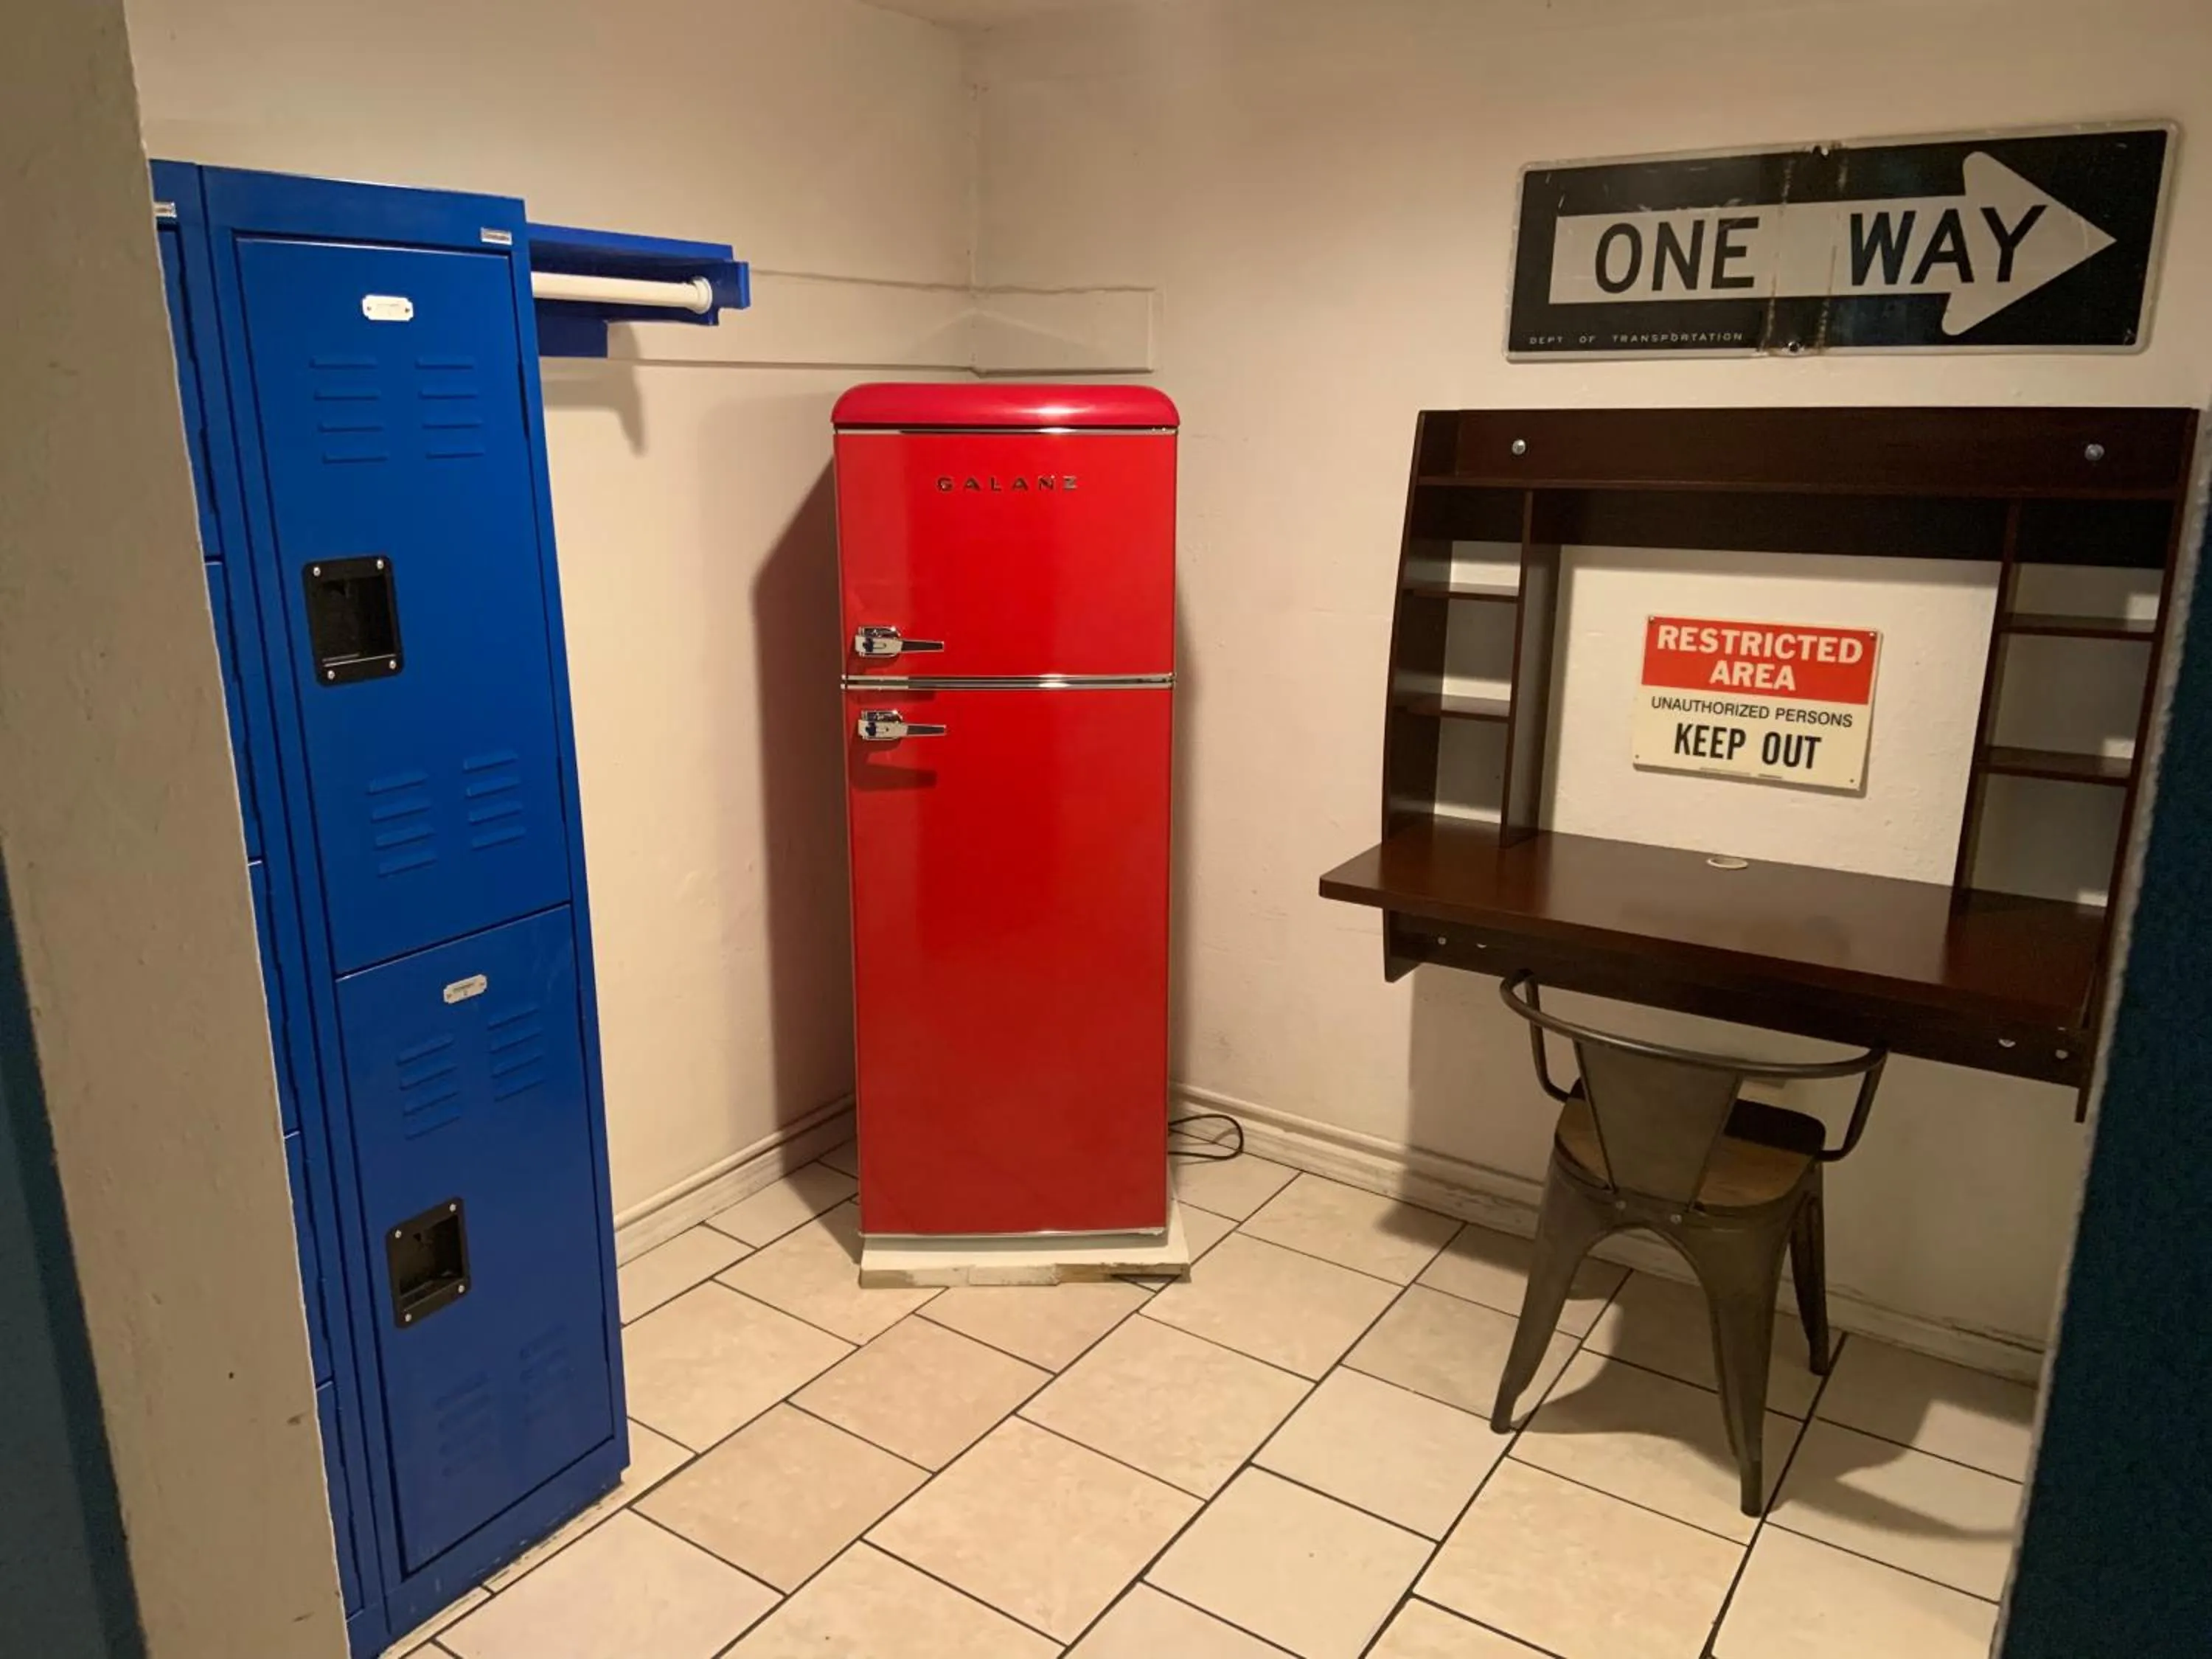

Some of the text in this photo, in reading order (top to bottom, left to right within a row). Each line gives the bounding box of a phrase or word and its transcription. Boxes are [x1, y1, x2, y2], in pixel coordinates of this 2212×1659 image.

[1595, 204, 2048, 293] ONE WAY
[1529, 332, 1744, 345] DEPT OF TRANSPORTATION
[936, 476, 1077, 492] GALANZ
[1658, 625, 1864, 664] RESTRICTED
[1709, 660, 1796, 691] AREA
[1651, 696, 1853, 728] UNAUTHORIZED PERSONS
[1674, 723, 1822, 769] KEEP OUT
